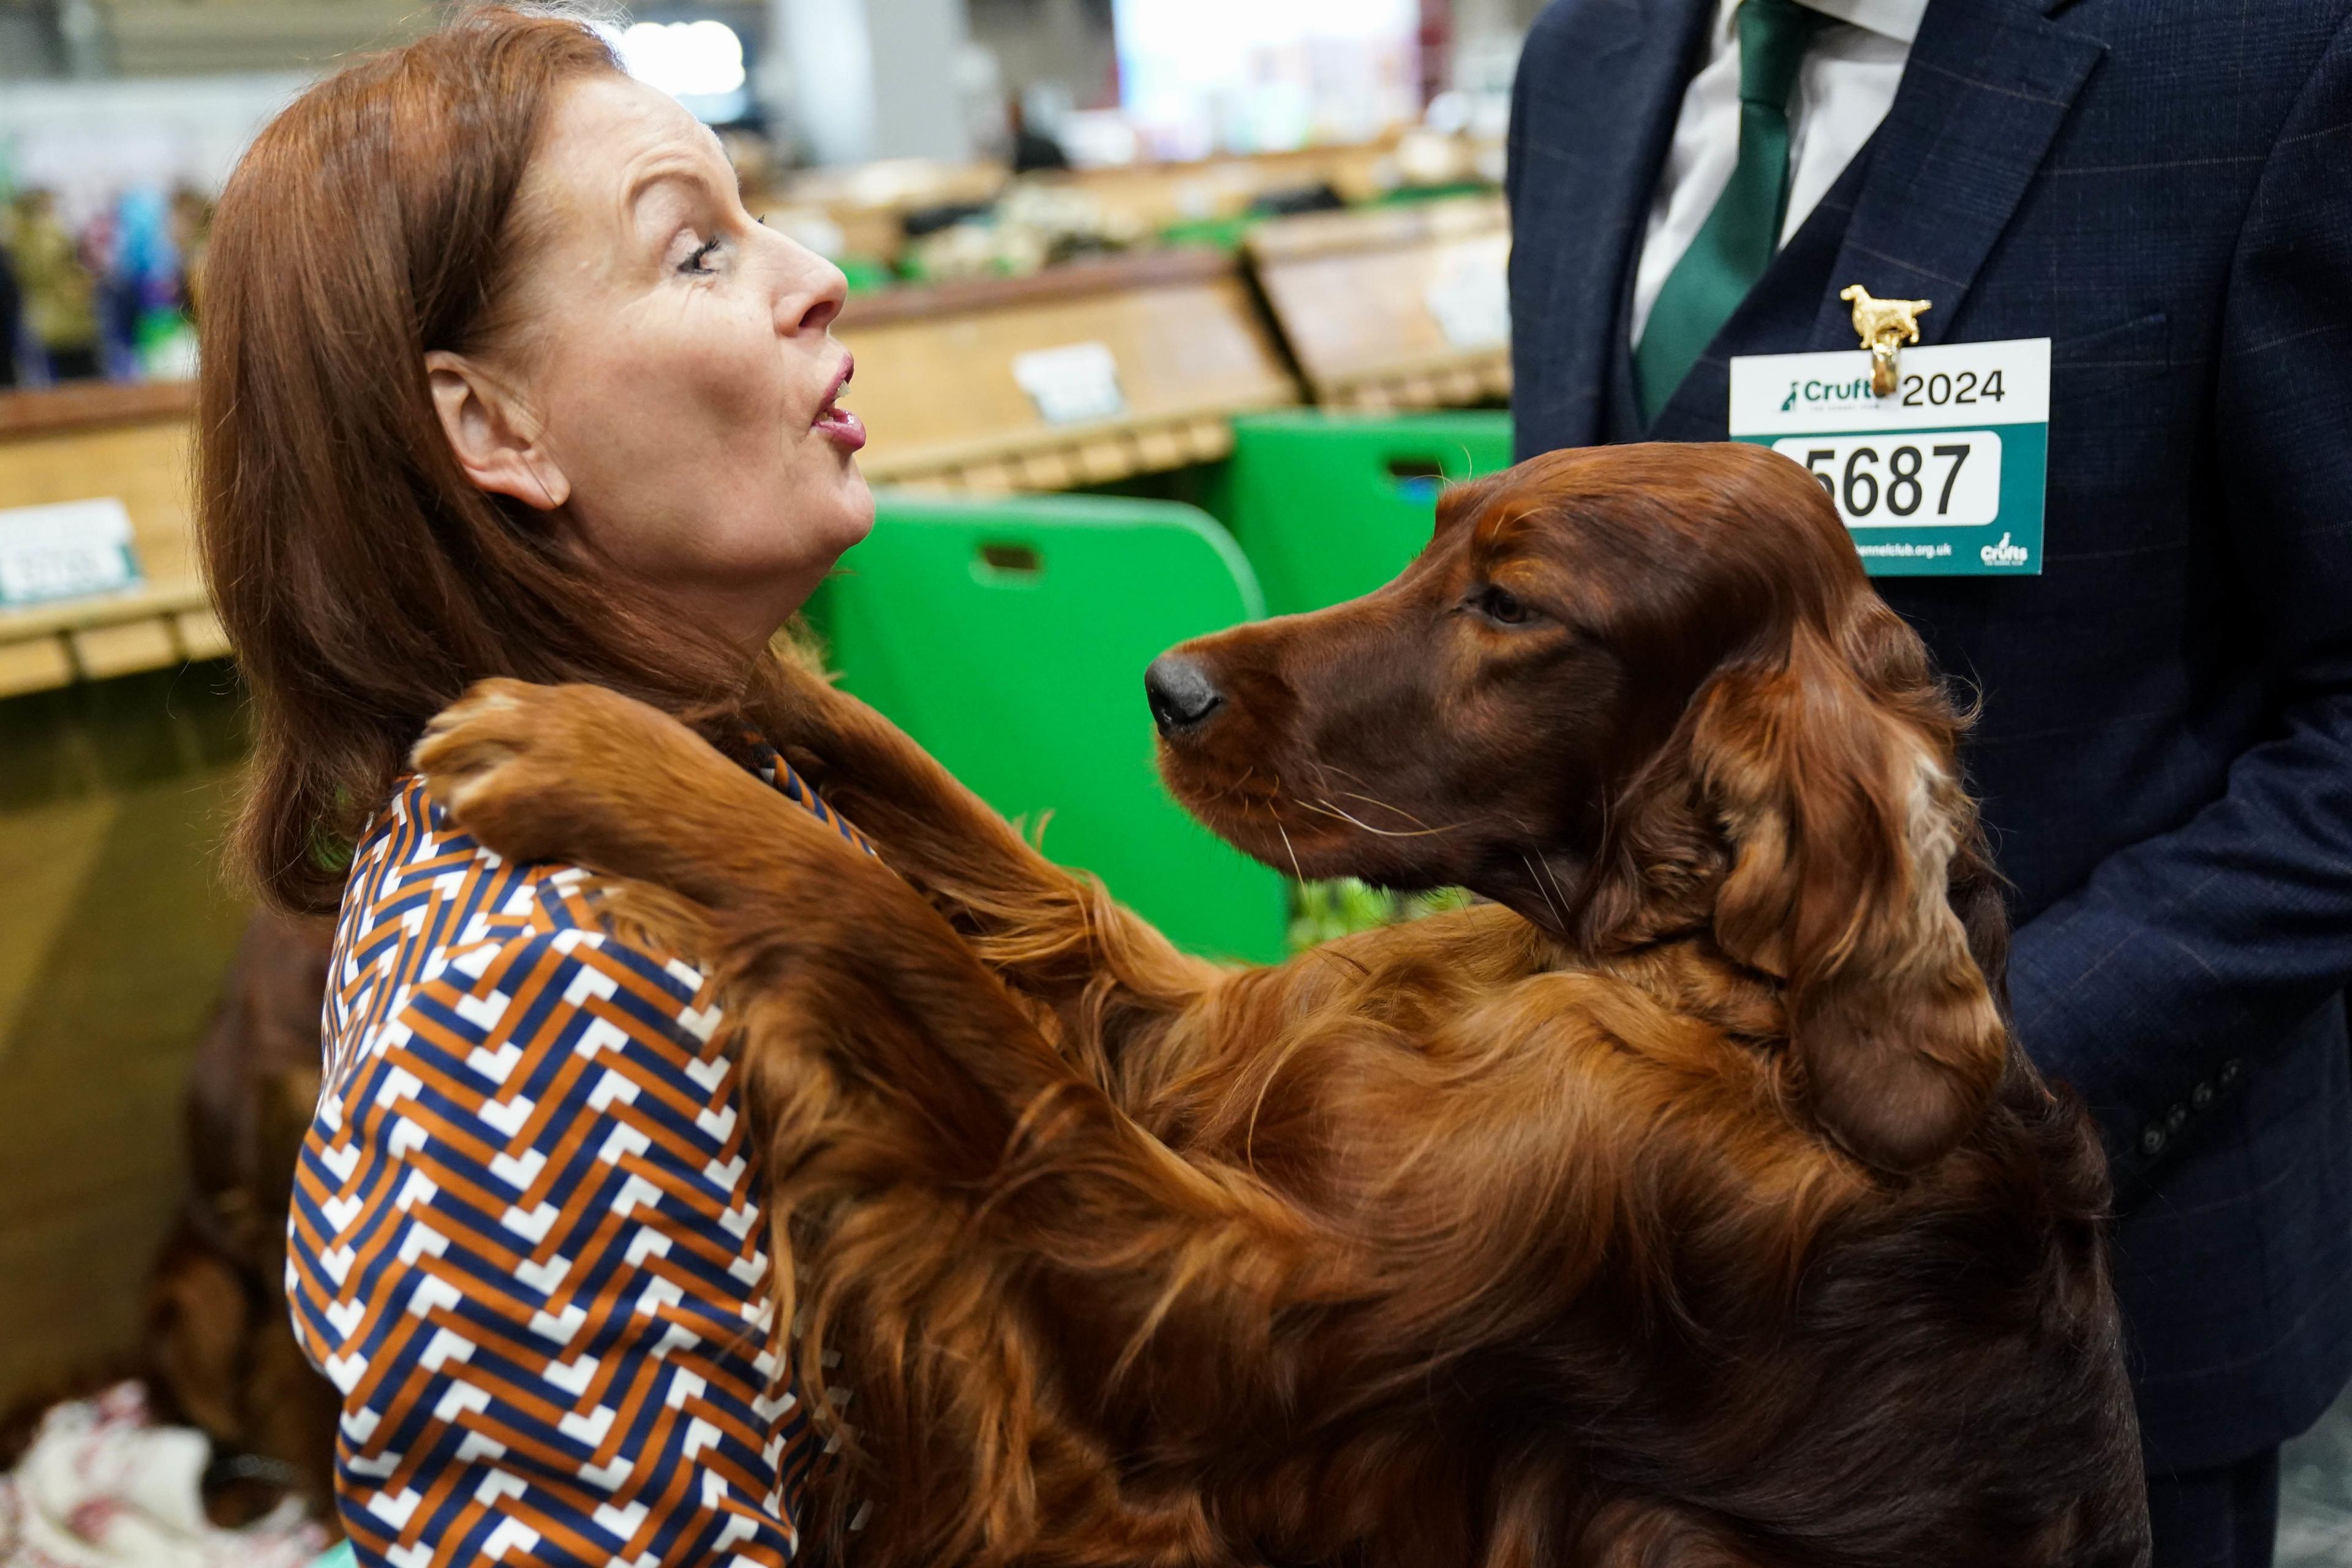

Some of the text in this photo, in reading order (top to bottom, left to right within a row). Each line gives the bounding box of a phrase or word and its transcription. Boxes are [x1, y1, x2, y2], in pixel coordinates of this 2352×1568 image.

[1804, 370, 2005, 407] Cruft 2024
[1806, 445, 1970, 517] 5687
[1980, 545, 2028, 562] Crufts
